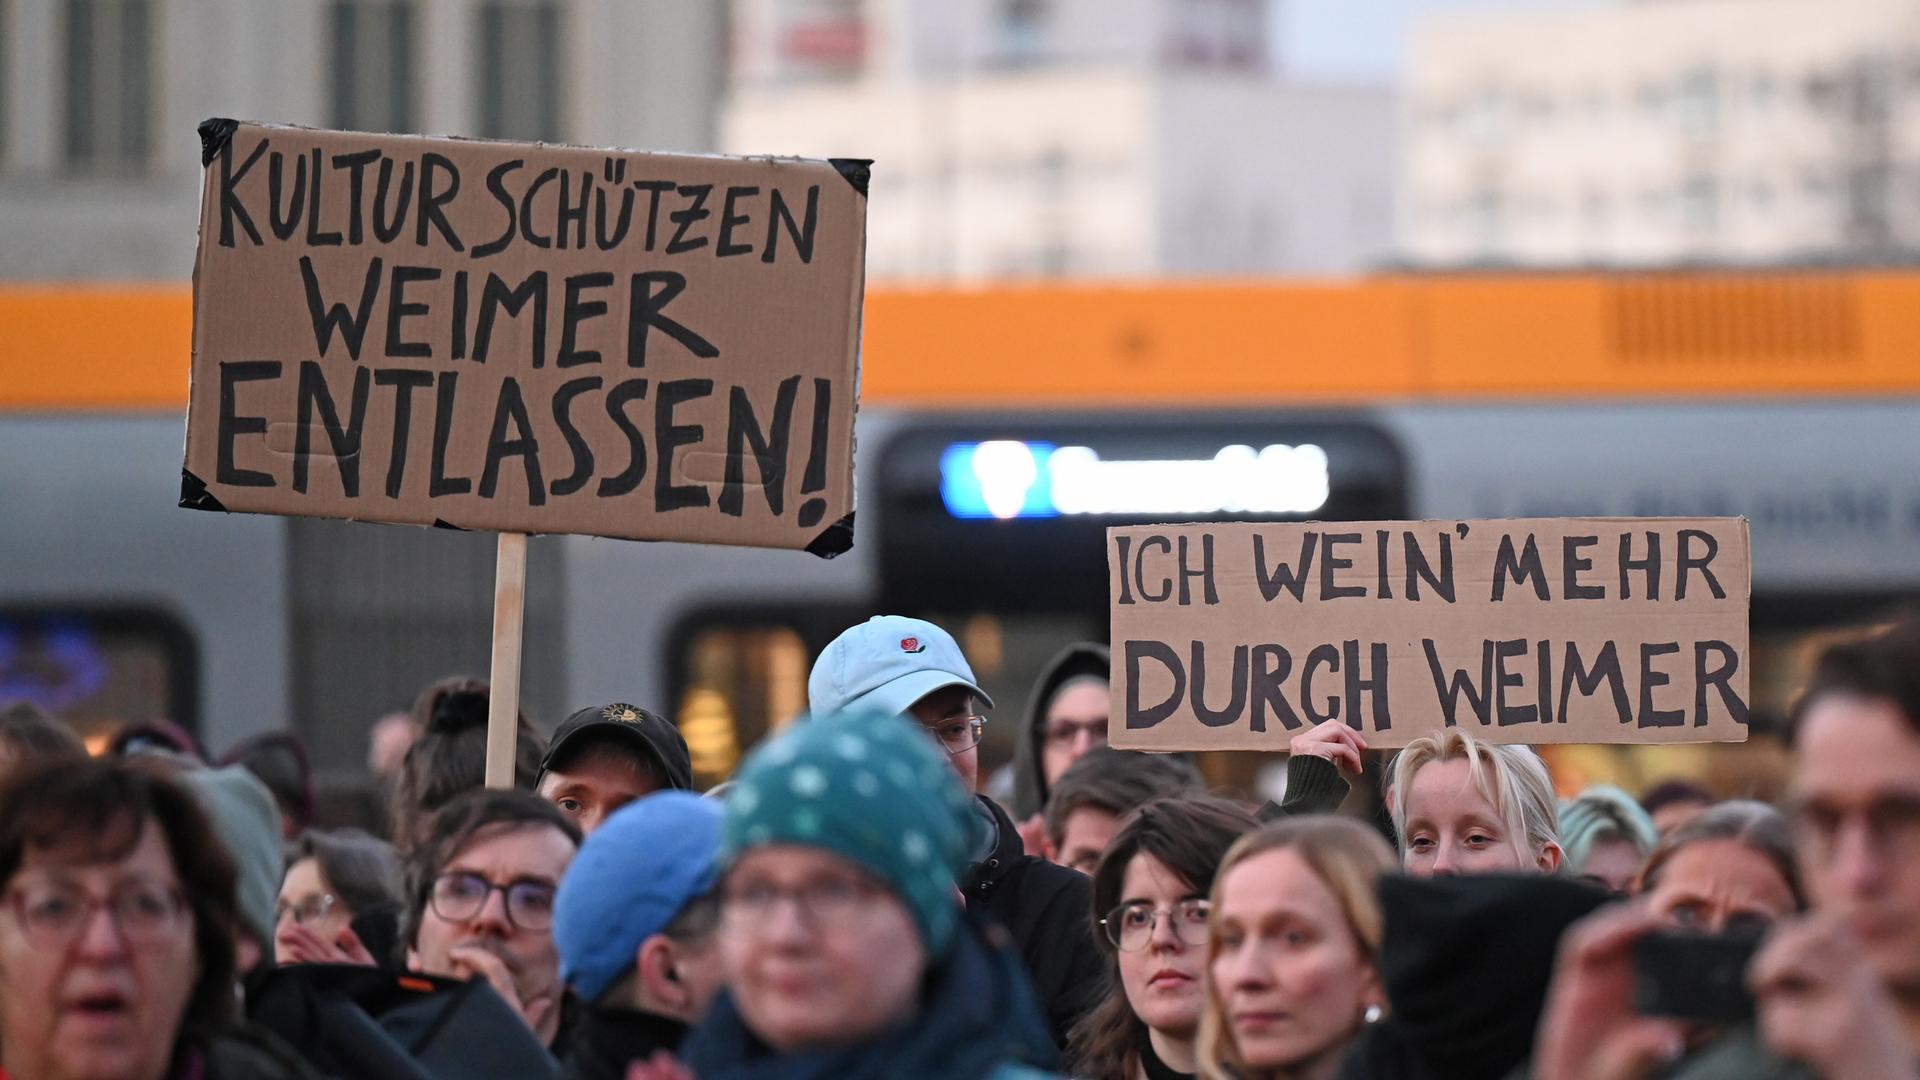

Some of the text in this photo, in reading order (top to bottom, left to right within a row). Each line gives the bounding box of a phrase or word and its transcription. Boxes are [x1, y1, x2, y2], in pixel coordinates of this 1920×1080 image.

[299, 256, 720, 369] WEIMER
[216, 360, 832, 528] ENTLASSEN!
[1116, 534, 1219, 605] ICH
[1491, 529, 1726, 602] MEHR
[1125, 639, 1748, 732] DURCH WEIMER
